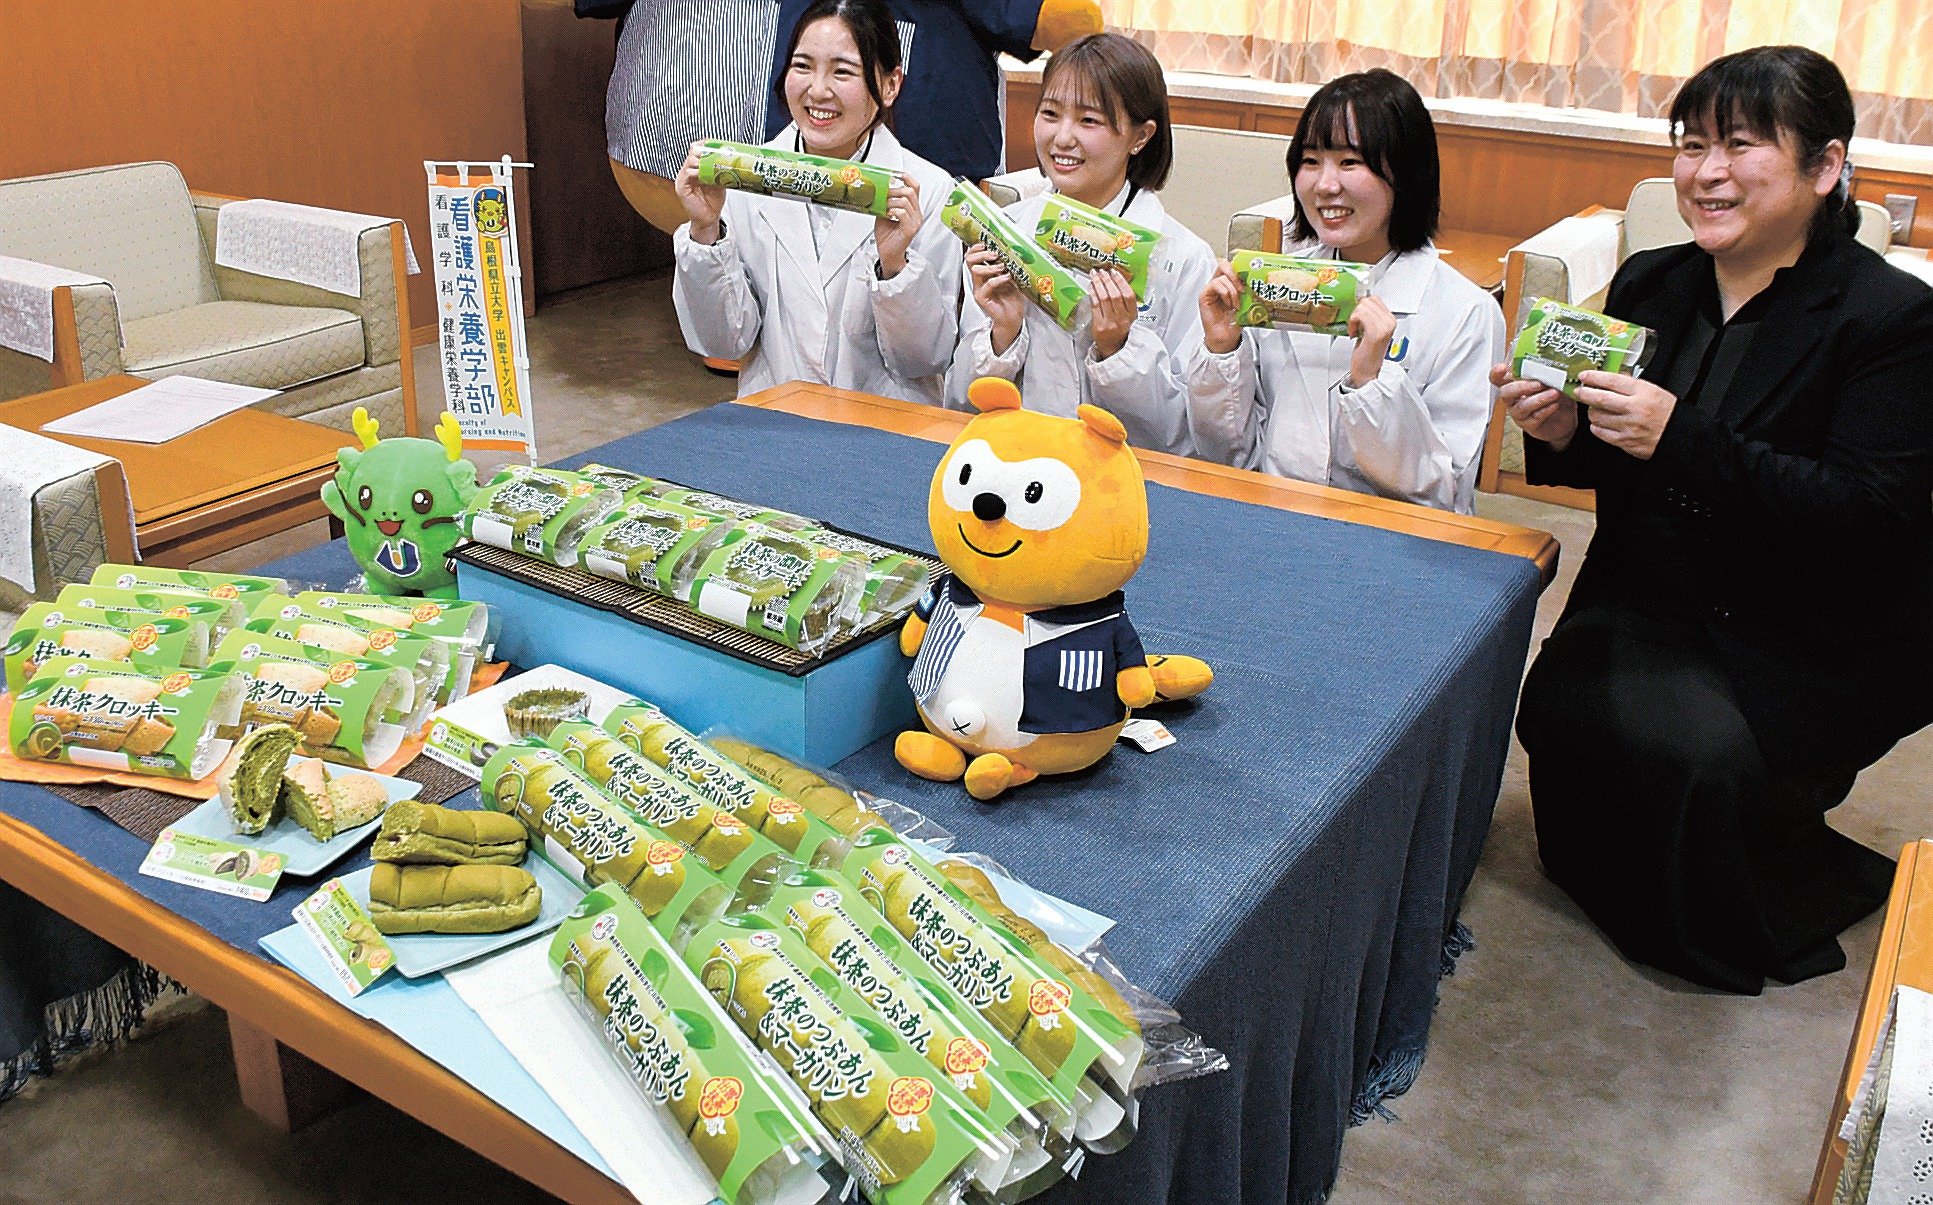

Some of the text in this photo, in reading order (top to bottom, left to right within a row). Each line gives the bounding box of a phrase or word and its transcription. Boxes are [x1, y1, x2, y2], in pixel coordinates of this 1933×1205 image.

[753, 160, 832, 186] 抹茶のつぶあん
[1053, 229, 1130, 265] 抹茶クロッキー
[435, 194, 466, 414] 看護学科 健康栄養学科
[450, 196, 495, 416] 看護栄養学部
[485, 240, 515, 408] 島根県立大学 出雲キャンパス
[1250, 279, 1334, 305] 抹茶クロッキー
[459, 418, 479, 427] aculty
[49, 687, 178, 720] 抹茶クロッキー
[237, 672, 342, 712] 茶クロッキー
[605, 778, 678, 827] &マーガリン
[608, 752, 701, 818] 抹茶のつぶあん
[664, 737, 756, 807] 抹茶のつぶあん
[544, 806, 615, 863] &マーガリン
[548, 779, 637, 855] 抹茶のつぶあん
[909, 894, 1015, 1002] 抹茶のつぶあん
[910, 934, 994, 1009] &マーガリン
[830, 938, 934, 1055] 抹茶のつぶあん
[604, 973, 691, 1099] 抹茶のつぶあん
[604, 1015, 669, 1103] &マーガリン
[760, 1012, 847, 1098] &マーガリン
[765, 977, 876, 1095] 抹茶のつぶあん
